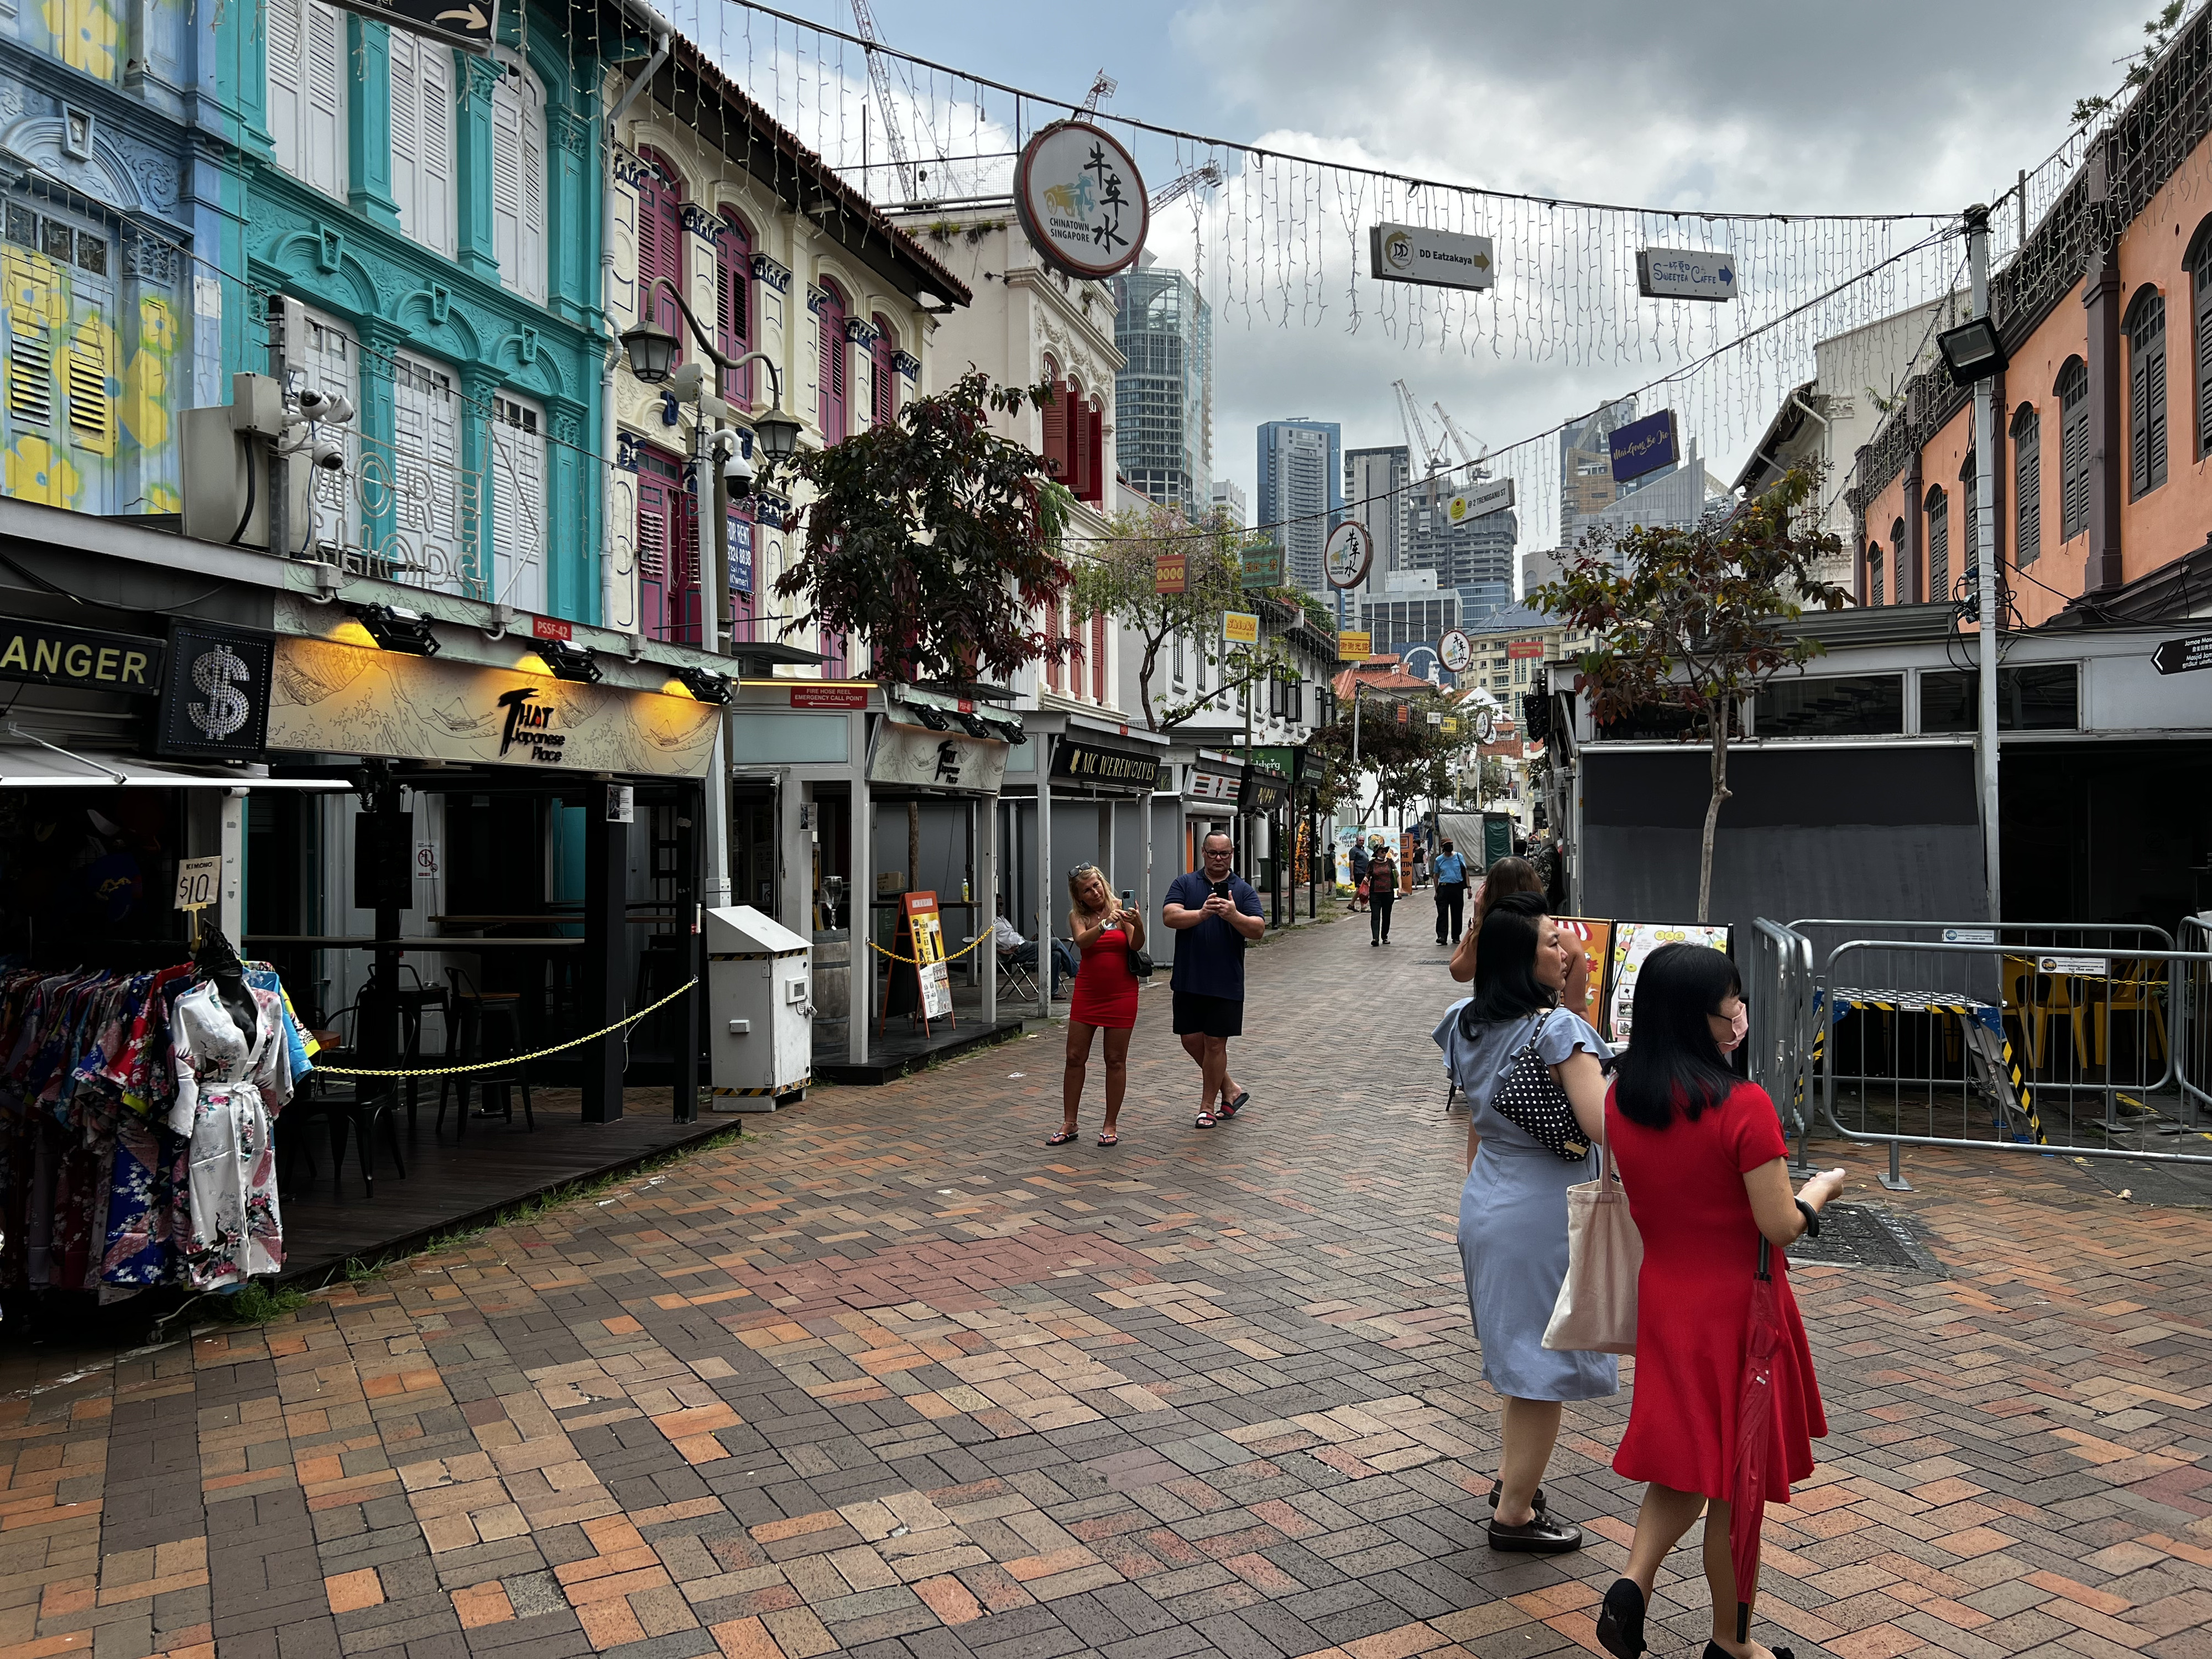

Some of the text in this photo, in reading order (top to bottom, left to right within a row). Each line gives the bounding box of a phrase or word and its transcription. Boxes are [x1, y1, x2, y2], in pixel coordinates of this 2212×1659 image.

[1083, 141, 1129, 255] 牛车水
[1050, 217, 1090, 232] CHINATOWN
[1050, 228, 1090, 243] SINGAPORE
[1420, 249, 1473, 265] DD Eatzakaya
[1500, 488, 1506, 497] ST
[737, 524, 750, 546] RENT
[1345, 528, 1360, 578] 牛车水
[537, 620, 568, 638] PSSF-42
[1227, 618, 1255, 632] Shiok!
[0, 636, 148, 685] ANGER
[497, 687, 555, 757] THAT
[512, 728, 565, 745] Japanese
[531, 746, 562, 761] Place
[1099, 755, 1156, 781] WEREWOLVES
[186, 862, 213, 870] KIMONO
[179, 873, 209, 904] $10
